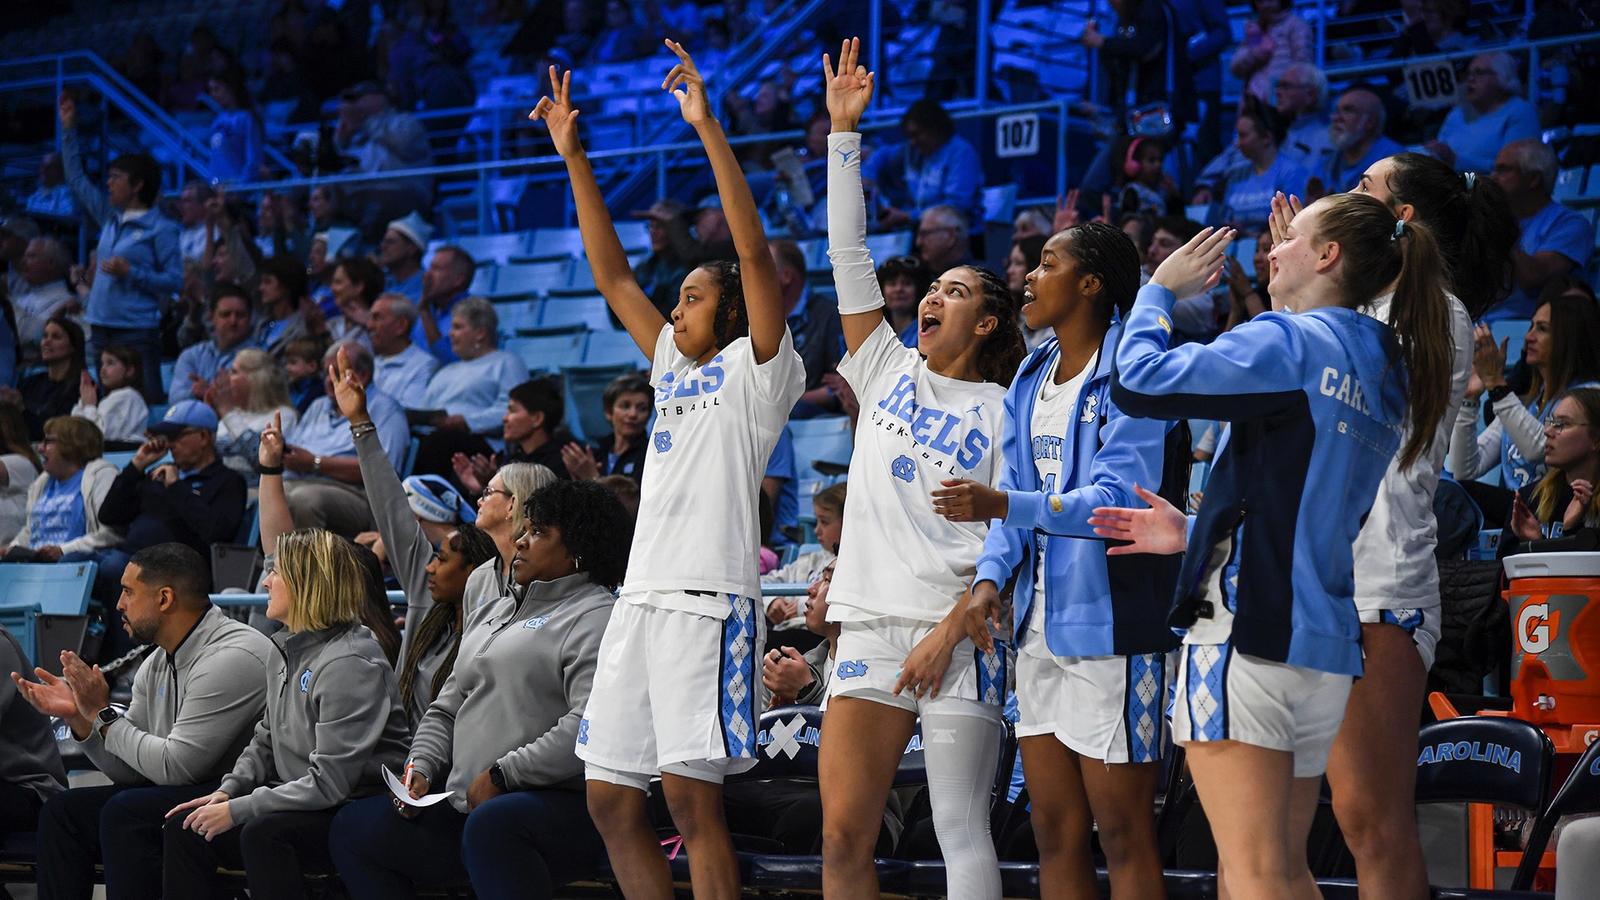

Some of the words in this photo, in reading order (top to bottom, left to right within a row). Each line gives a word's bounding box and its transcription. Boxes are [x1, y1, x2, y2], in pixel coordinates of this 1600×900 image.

[1410, 67, 1455, 100] 108
[1003, 120, 1034, 149] 107
[1518, 603, 1550, 654] G
